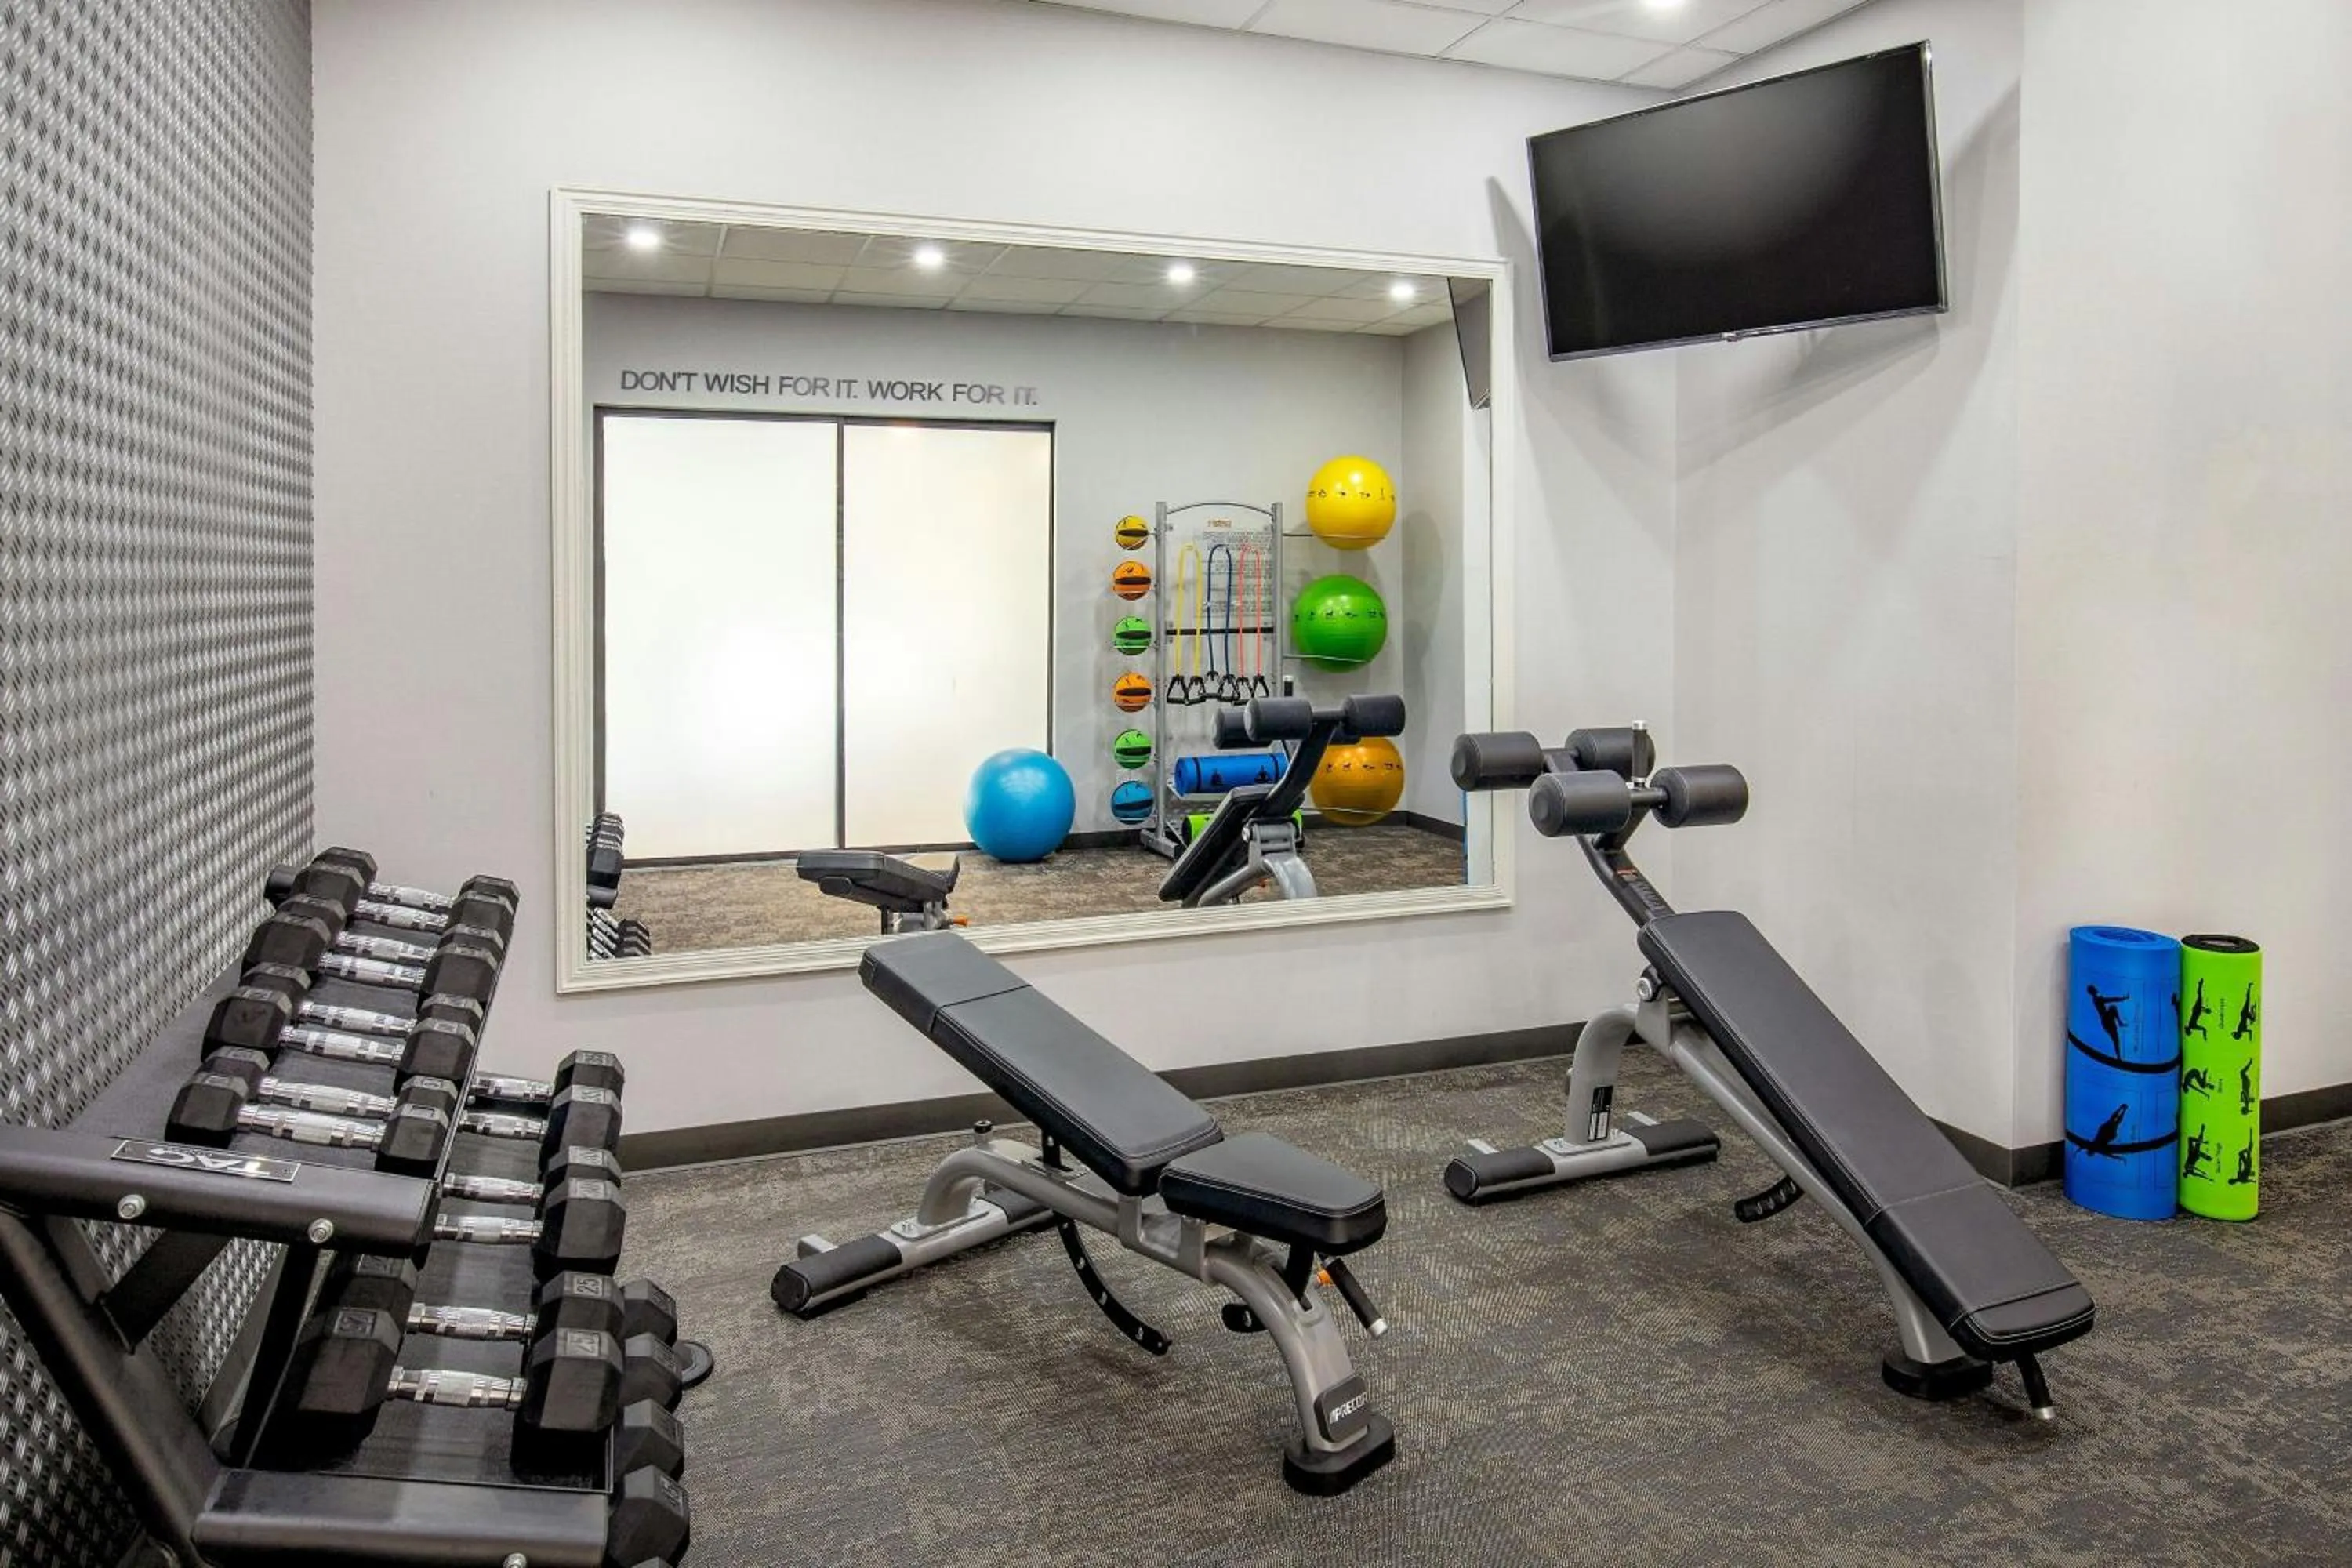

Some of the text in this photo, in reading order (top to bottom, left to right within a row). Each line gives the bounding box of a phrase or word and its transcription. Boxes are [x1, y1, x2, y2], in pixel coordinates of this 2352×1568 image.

[621, 370, 1038, 405] DON'T WISH FOR IT. WORK FOR IT.
[577, 1278, 600, 1294] 25
[1334, 1392, 1368, 1421] PRECOR
